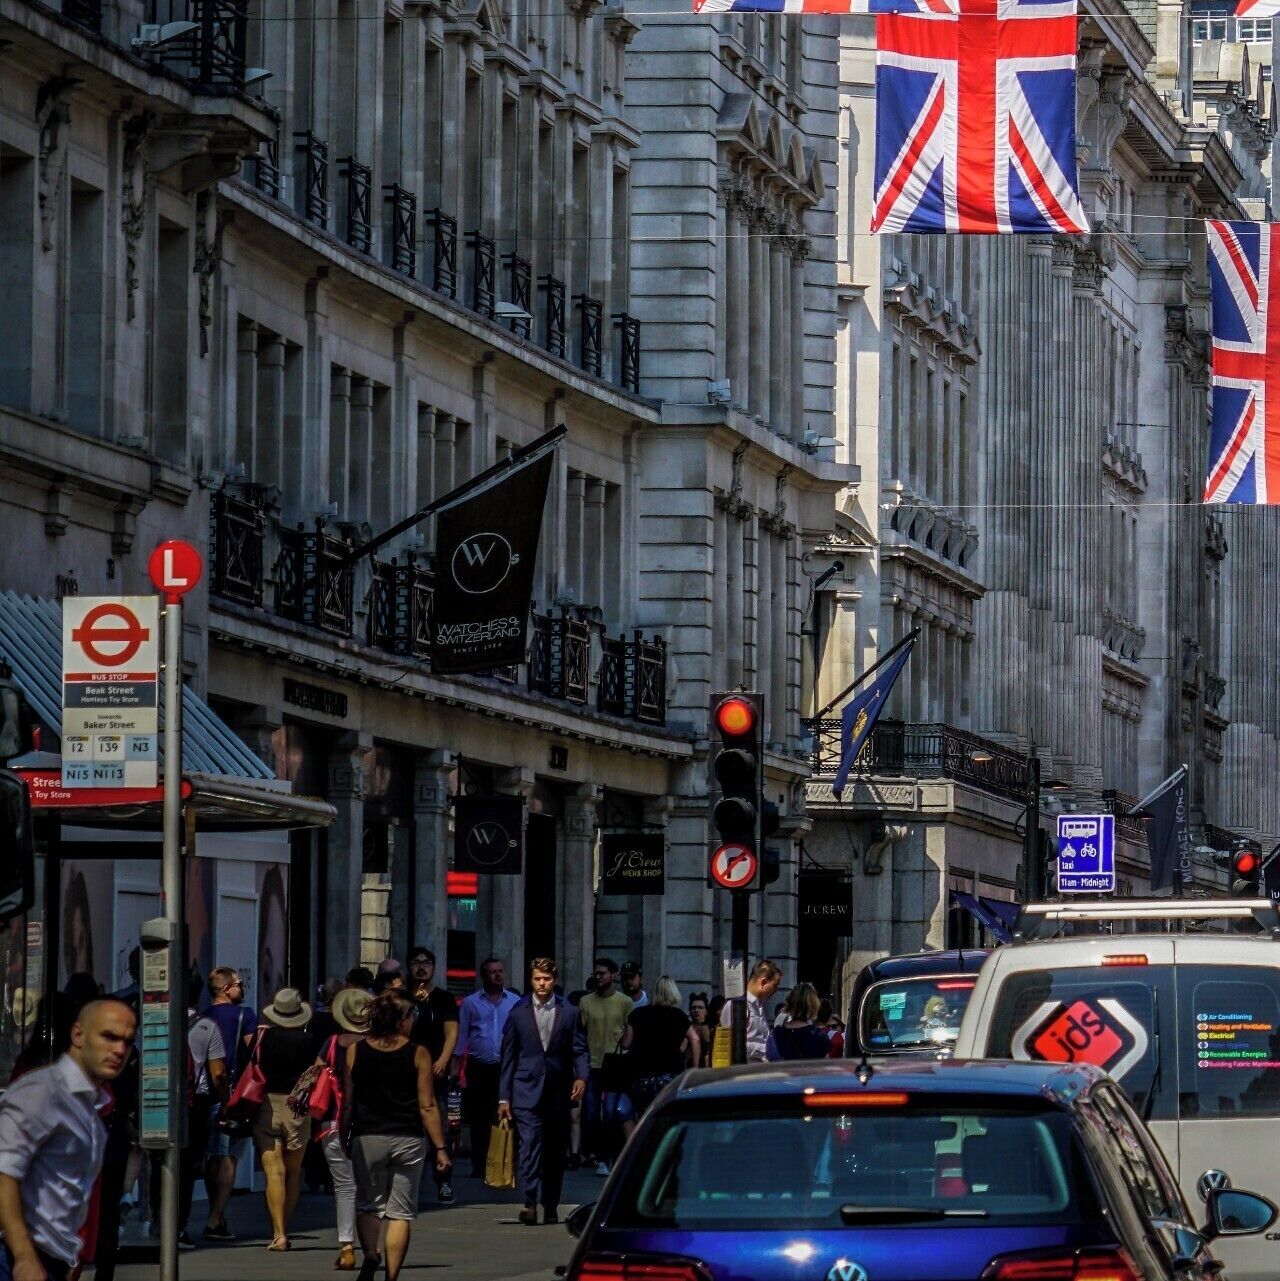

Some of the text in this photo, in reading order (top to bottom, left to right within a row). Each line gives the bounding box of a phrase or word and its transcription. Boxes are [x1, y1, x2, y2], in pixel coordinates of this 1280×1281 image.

[164, 549, 188, 587] L
[438, 618, 508, 635] WATCHES
[436, 627, 521, 645] SWITZERLAND
[91, 673, 128, 681] BUS STOP
[85, 686, 136, 695] Beak Street
[108, 696, 119, 704] Toy
[83, 721, 136, 729] Baker Street
[71, 742, 84, 753] 12
[100, 742, 118, 753] 139
[132, 742, 149, 752] N3
[66, 770, 89, 780] N15
[93, 769, 124, 779] N113
[32, 777, 61, 787] Stree
[35, 791, 49, 799] Toy
[50, 791, 71, 799] Store
[1061, 860, 1075, 870] taxi
[1080, 877, 1110, 889] Midnight
[1217, 1013, 1253, 1021] Conditioning
[1241, 1051, 1267, 1059] Energies
